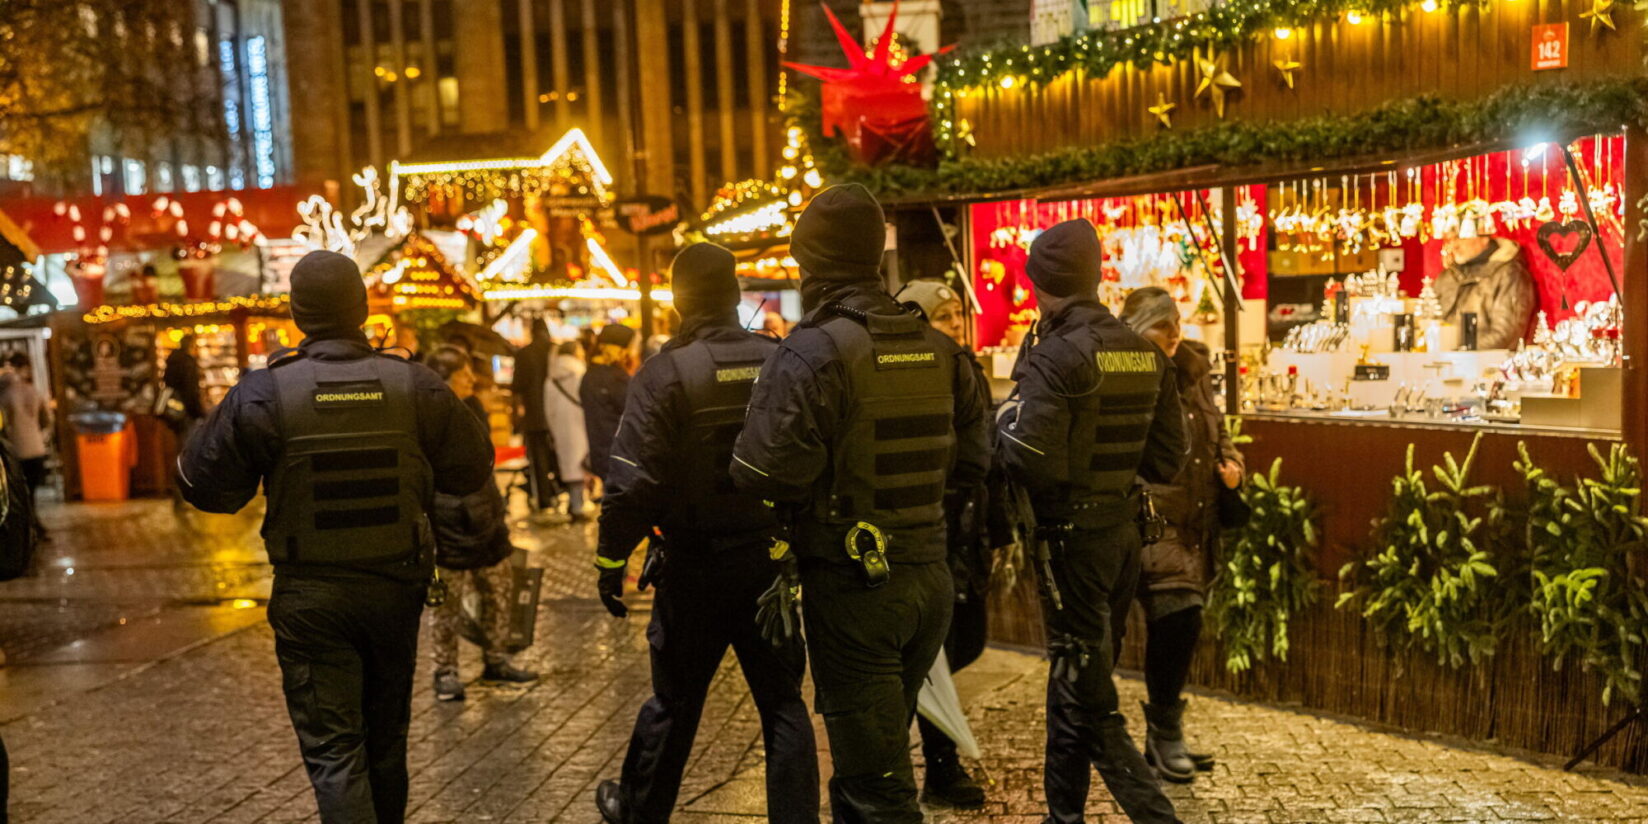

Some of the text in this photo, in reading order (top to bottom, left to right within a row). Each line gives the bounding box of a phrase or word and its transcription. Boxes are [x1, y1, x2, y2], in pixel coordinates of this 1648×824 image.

[1538, 40, 1560, 60] 142
[877, 352, 935, 364] ORDNUNGSAMT
[1096, 351, 1157, 373] ORDNUNGSAMT
[315, 391, 383, 402] ORDNUNGSAMT
